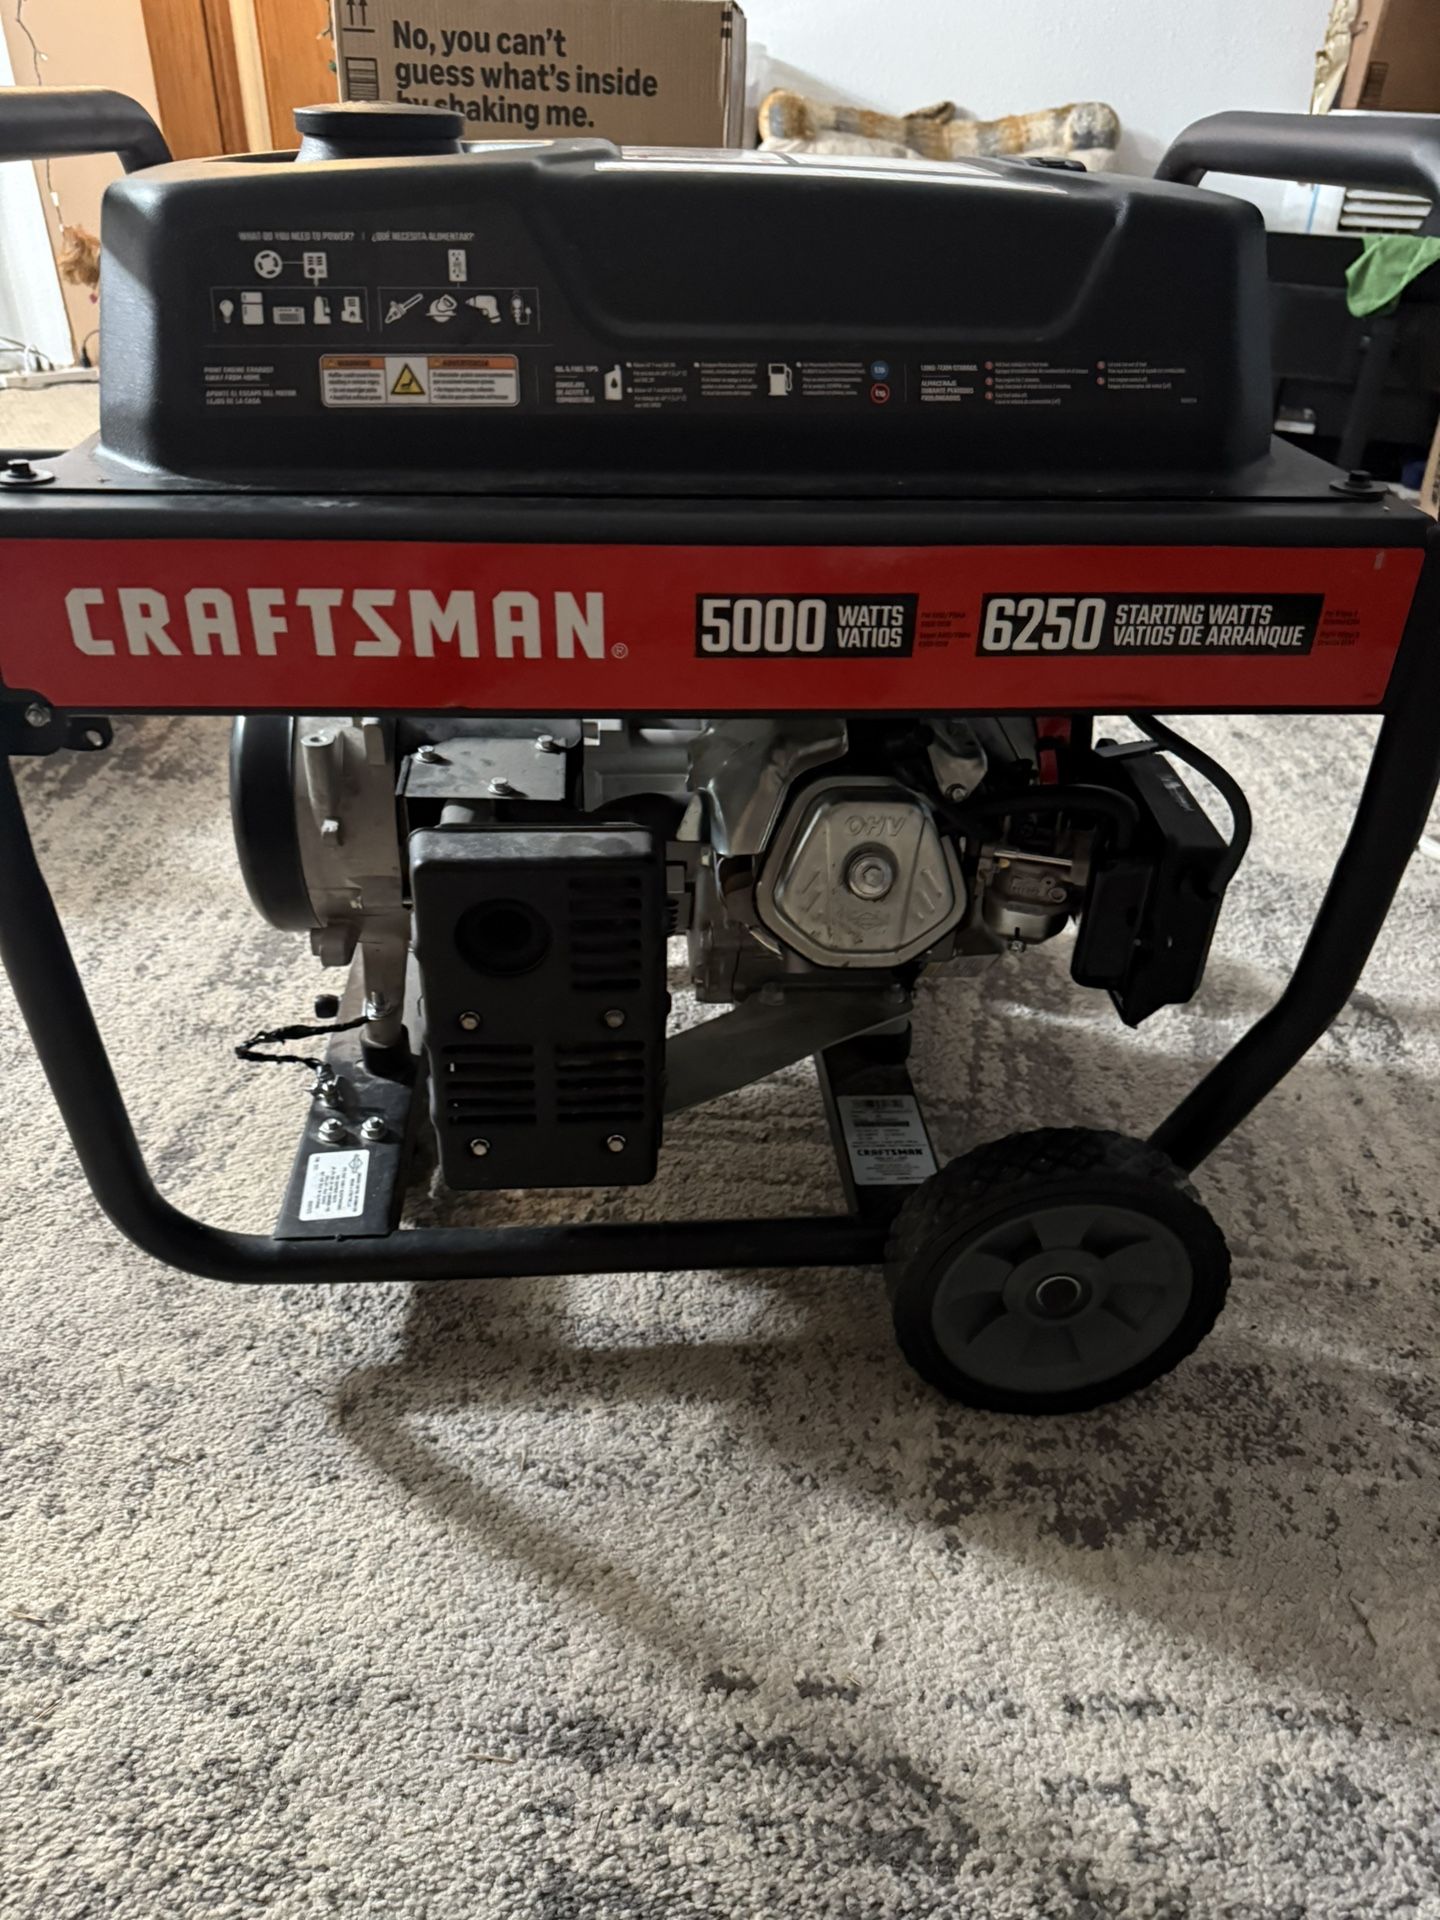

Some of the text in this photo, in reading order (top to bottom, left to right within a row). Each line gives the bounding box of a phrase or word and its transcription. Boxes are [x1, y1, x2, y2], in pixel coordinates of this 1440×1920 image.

[392, 19, 567, 57] No, you can't
[395, 61, 658, 96] guess what's inside
[546, 104, 594, 128] me.
[64, 588, 605, 659] CRAFTSMAN
[701, 599, 827, 652] 5000
[837, 605, 904, 627] WATTS
[982, 598, 1107, 650] 6250
[1115, 604, 1273, 625] STARTING WATTS
[836, 627, 904, 648] VATIOS
[1113, 626, 1176, 646] VATIOS
[1178, 626, 1205, 646] DE
[1205, 626, 1306, 648] ARRANQUE
[857, 1148, 923, 1157] CRAFTSMAN
